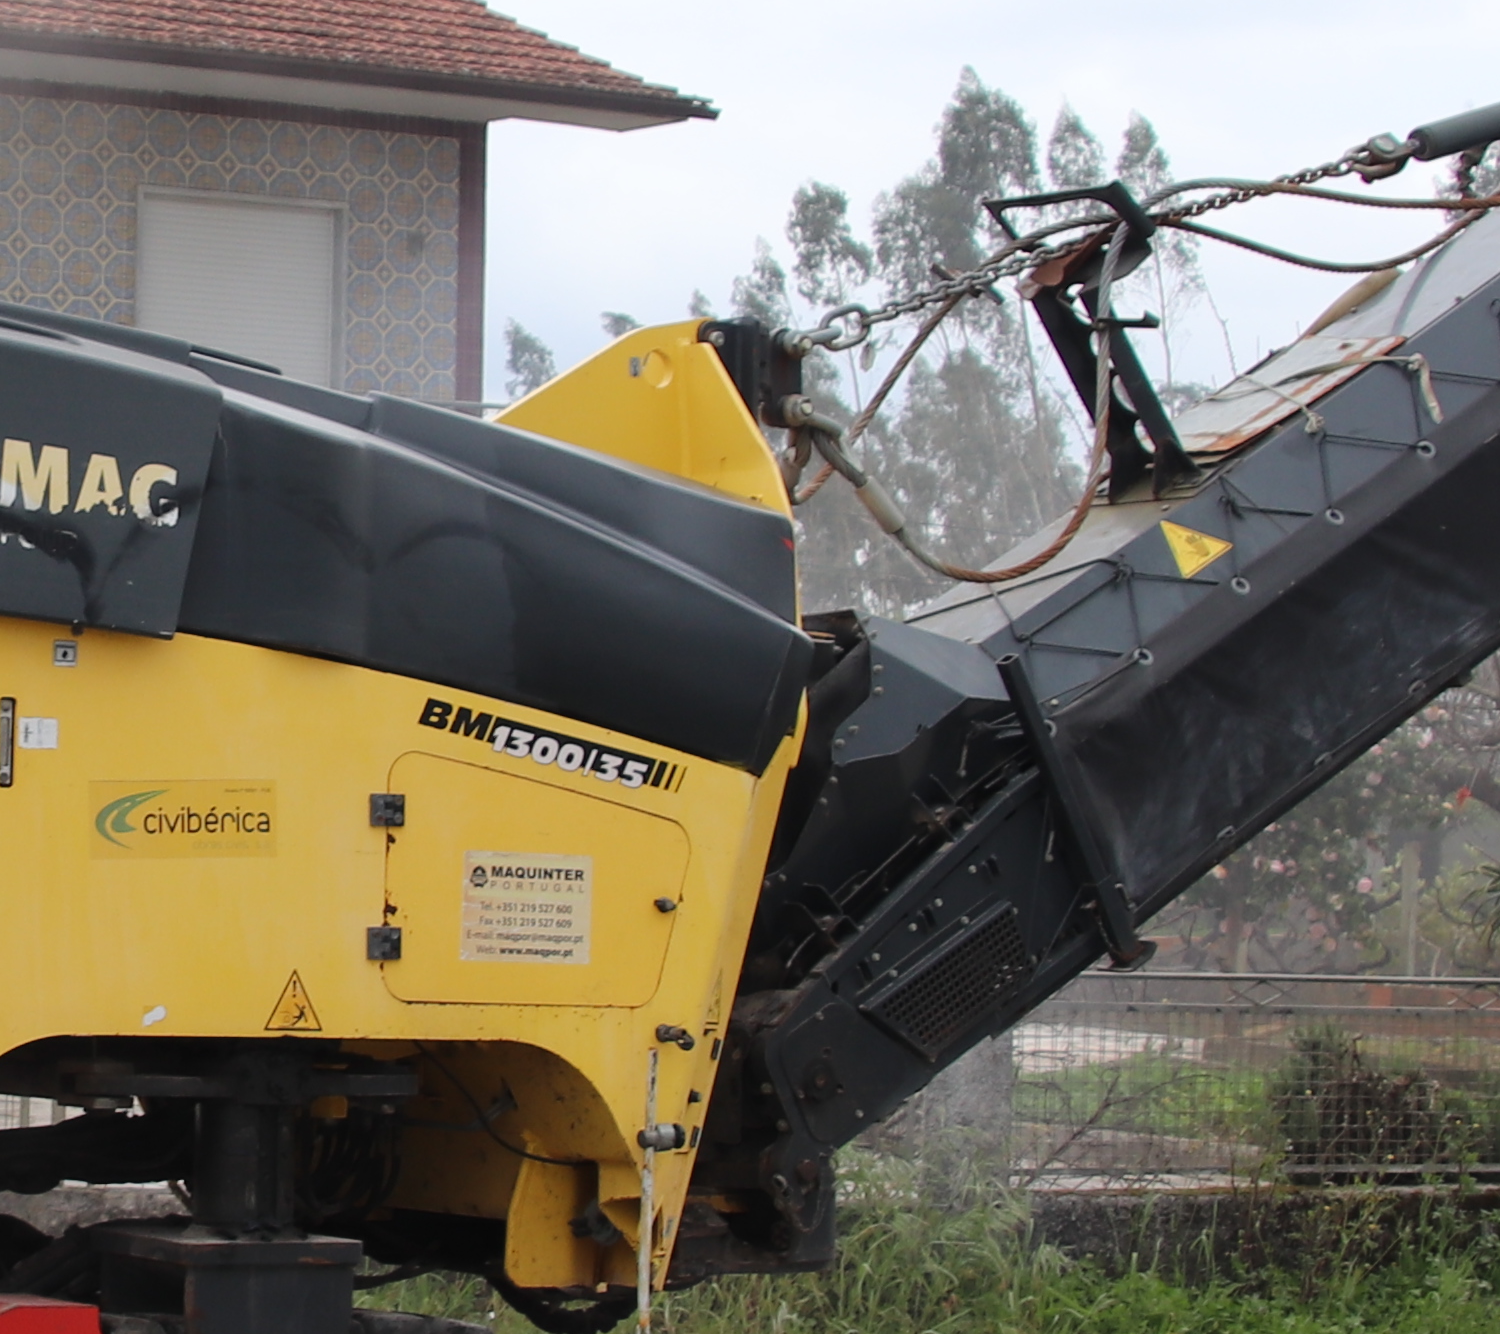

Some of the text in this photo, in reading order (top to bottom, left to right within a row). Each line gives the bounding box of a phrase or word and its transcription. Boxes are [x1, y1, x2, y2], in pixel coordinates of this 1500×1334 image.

[143, 805, 271, 835] civibérica
[490, 865, 585, 881] MAQUINTER
[490, 880, 585, 893] PORTUGAL
[497, 902, 517, 912] +351
[520, 903, 536, 913] 219
[538, 904, 554, 914] 527
[556, 904, 573, 915] 600
[496, 916, 517, 926] +351
[520, 917, 536, 927] 219
[538, 918, 554, 928] 527
[556, 919, 573, 929] 609
[499, 947, 574, 958] www.maqpor.pt
